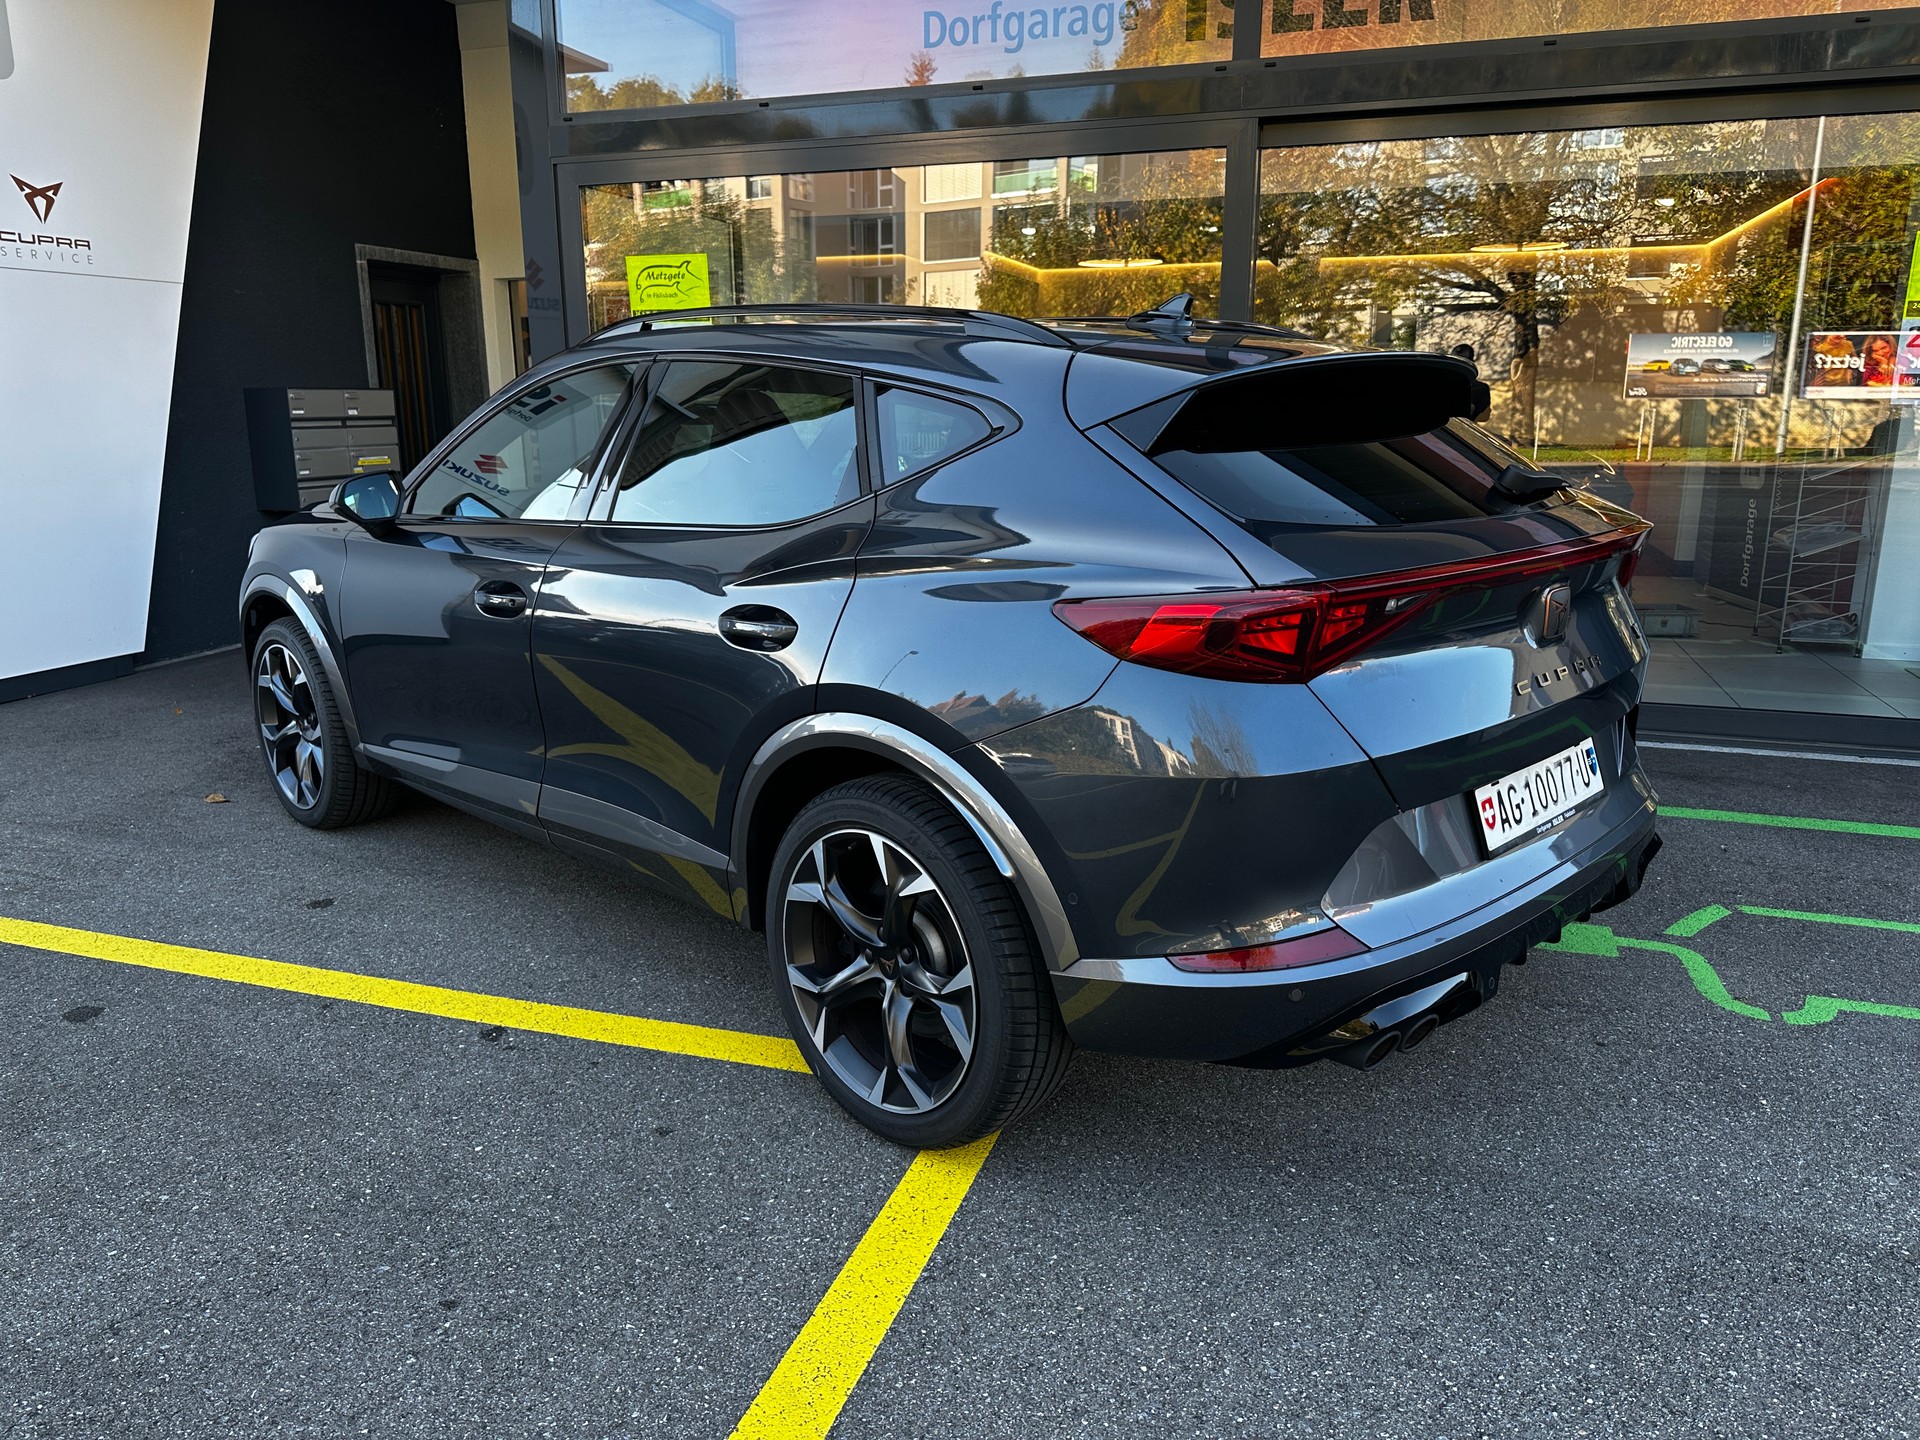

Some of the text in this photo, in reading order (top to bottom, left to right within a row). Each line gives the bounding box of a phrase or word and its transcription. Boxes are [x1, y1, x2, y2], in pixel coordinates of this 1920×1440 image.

[923, 0, 1139, 54] Dorfgarage
[0, 230, 91, 250] CUPRA
[0, 246, 94, 265] SERVICE
[1740, 499, 1757, 588] Dorfgarage
[1514, 654, 1602, 696] CUPRA
